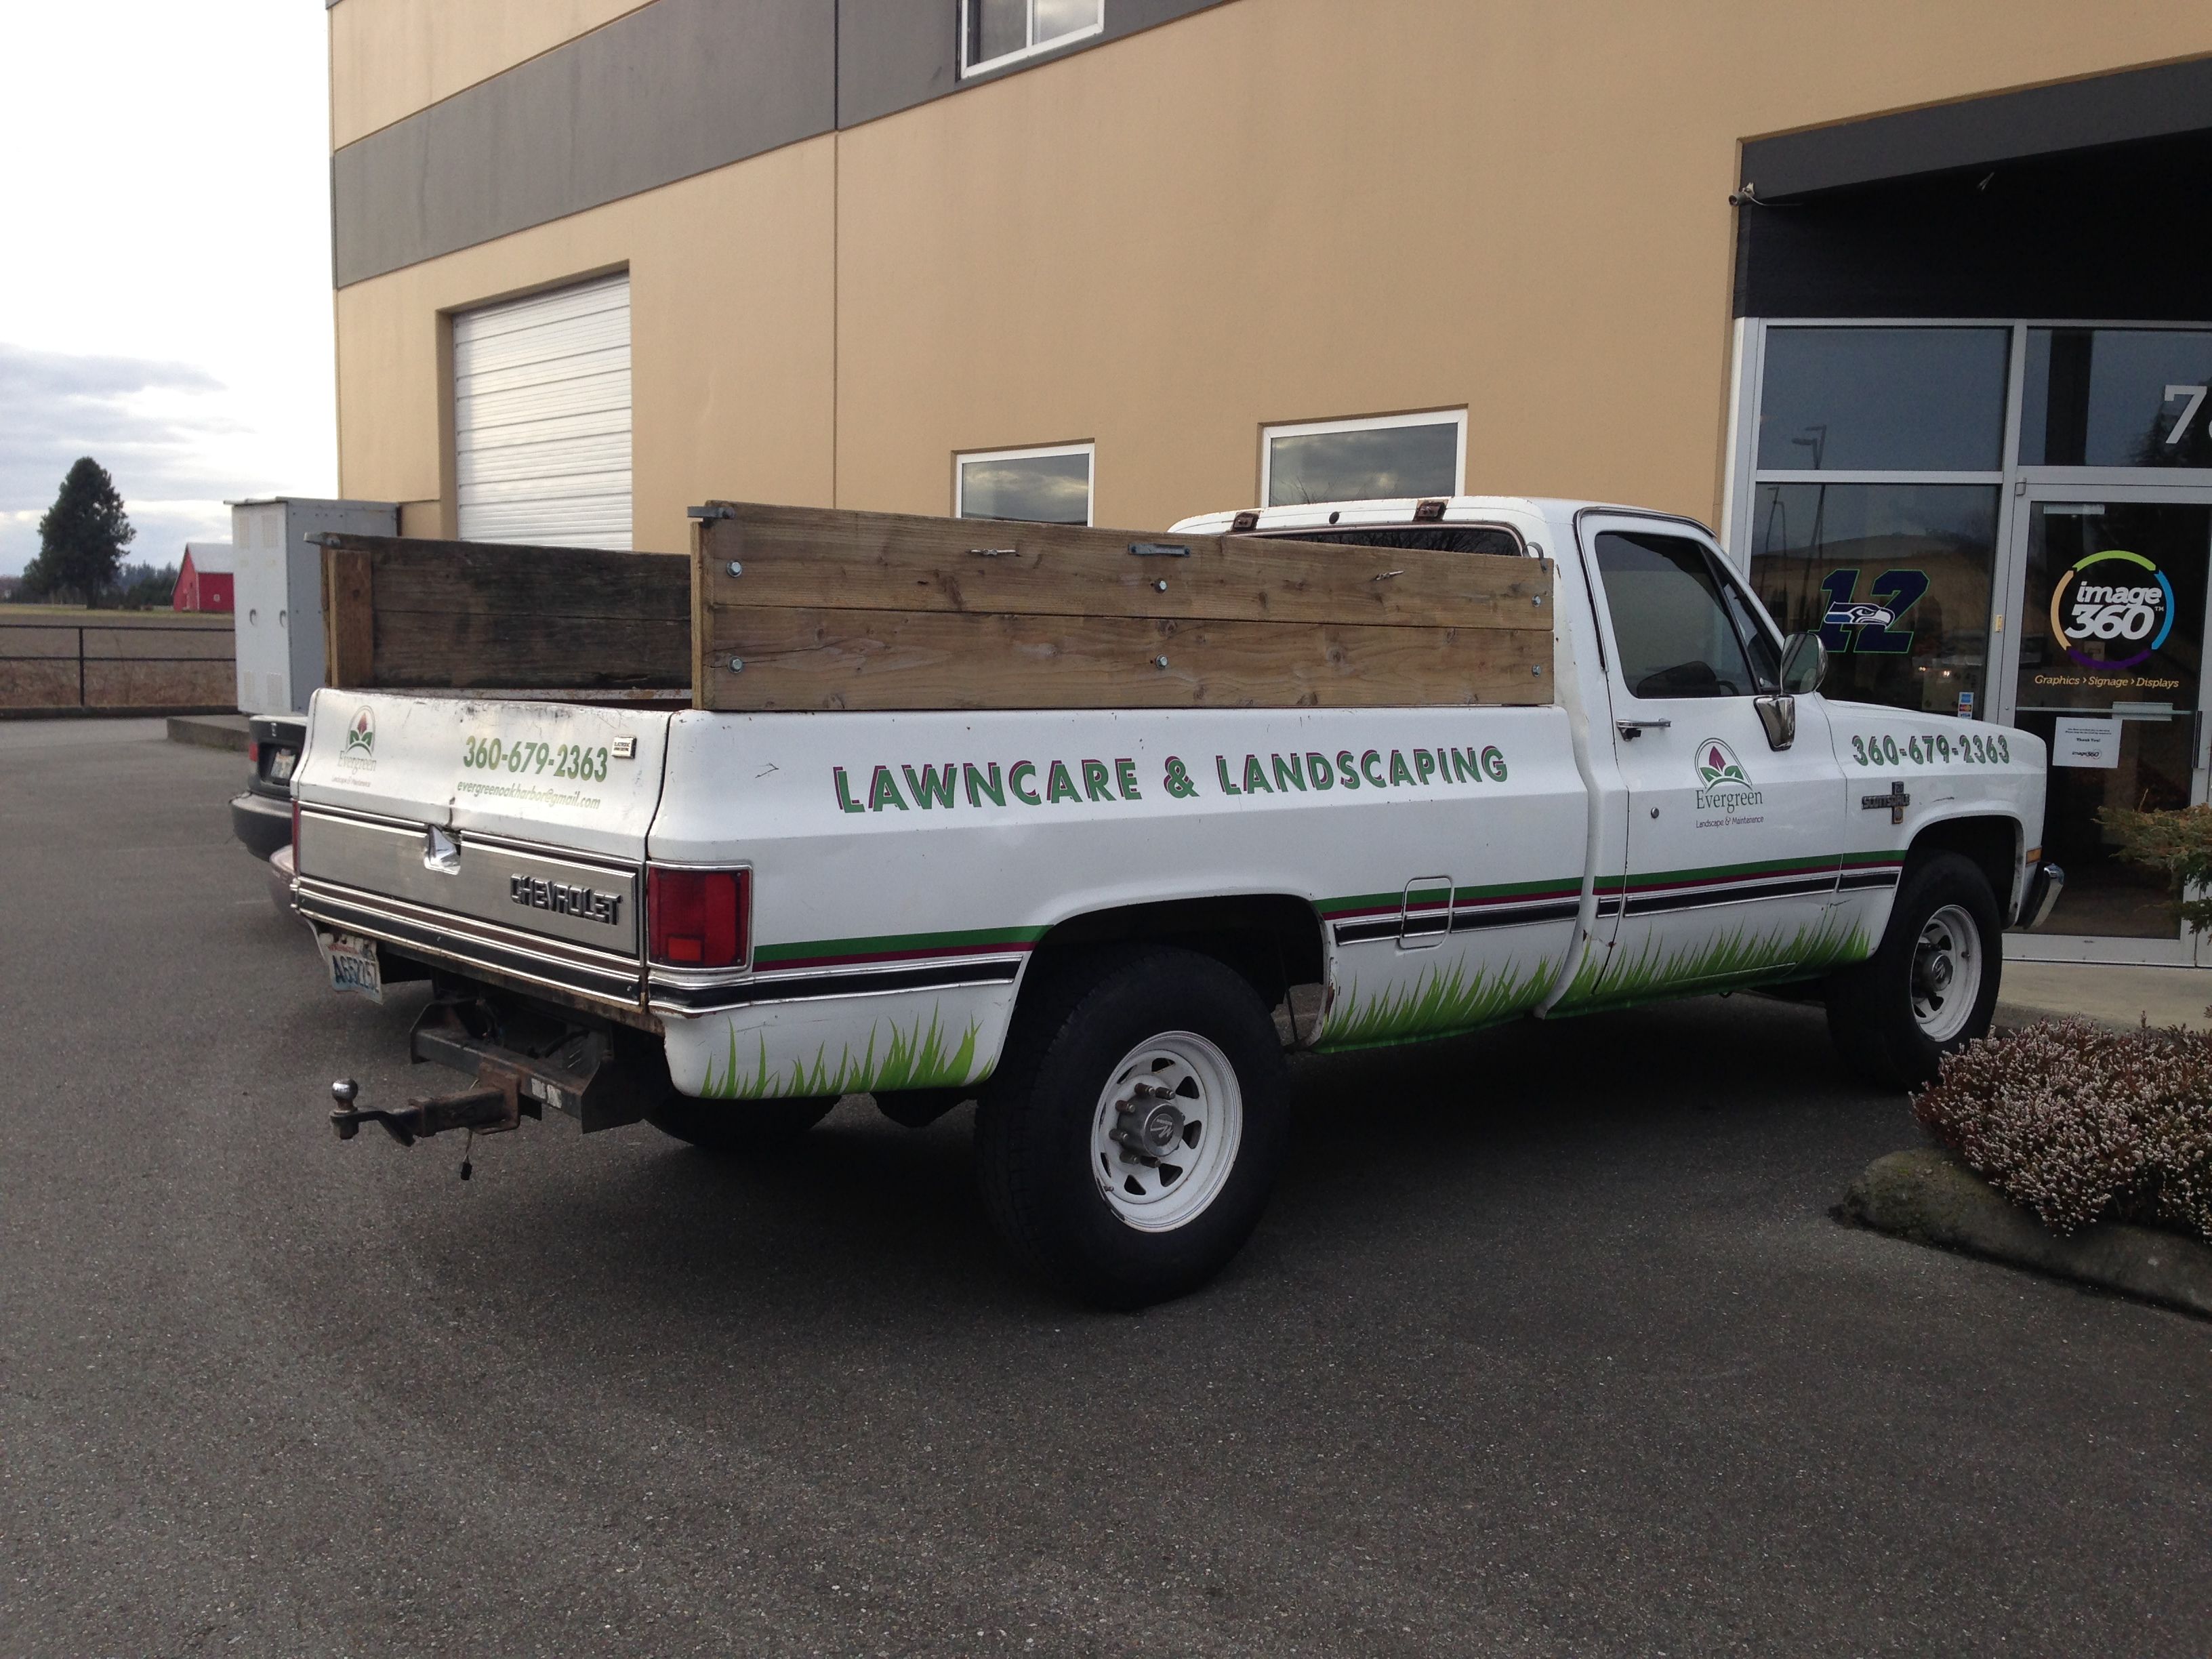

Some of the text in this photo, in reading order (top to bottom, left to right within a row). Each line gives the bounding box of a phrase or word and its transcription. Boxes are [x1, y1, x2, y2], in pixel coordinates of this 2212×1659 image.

[2165, 385, 2212, 445] 7
[2076, 581, 2163, 605] image
[1807, 569, 1930, 653] 12
[2064, 604, 2155, 640] 360
[2034, 674, 2179, 689] Graphics Signage Displays
[337, 750, 377, 775] Evergreen
[464, 735, 608, 783] 360-679-2363
[1851, 735, 2010, 766] 360-679-2363
[833, 745, 1508, 813] LAWNCARE & LANDSCAPING
[457, 780, 602, 810] evergreenoakharbor@gmail.com
[1696, 789, 1763, 814] Evergreen
[1696, 816, 1764, 828] Landscape & Maintenance
[510, 873, 623, 926] CHEVROLET
